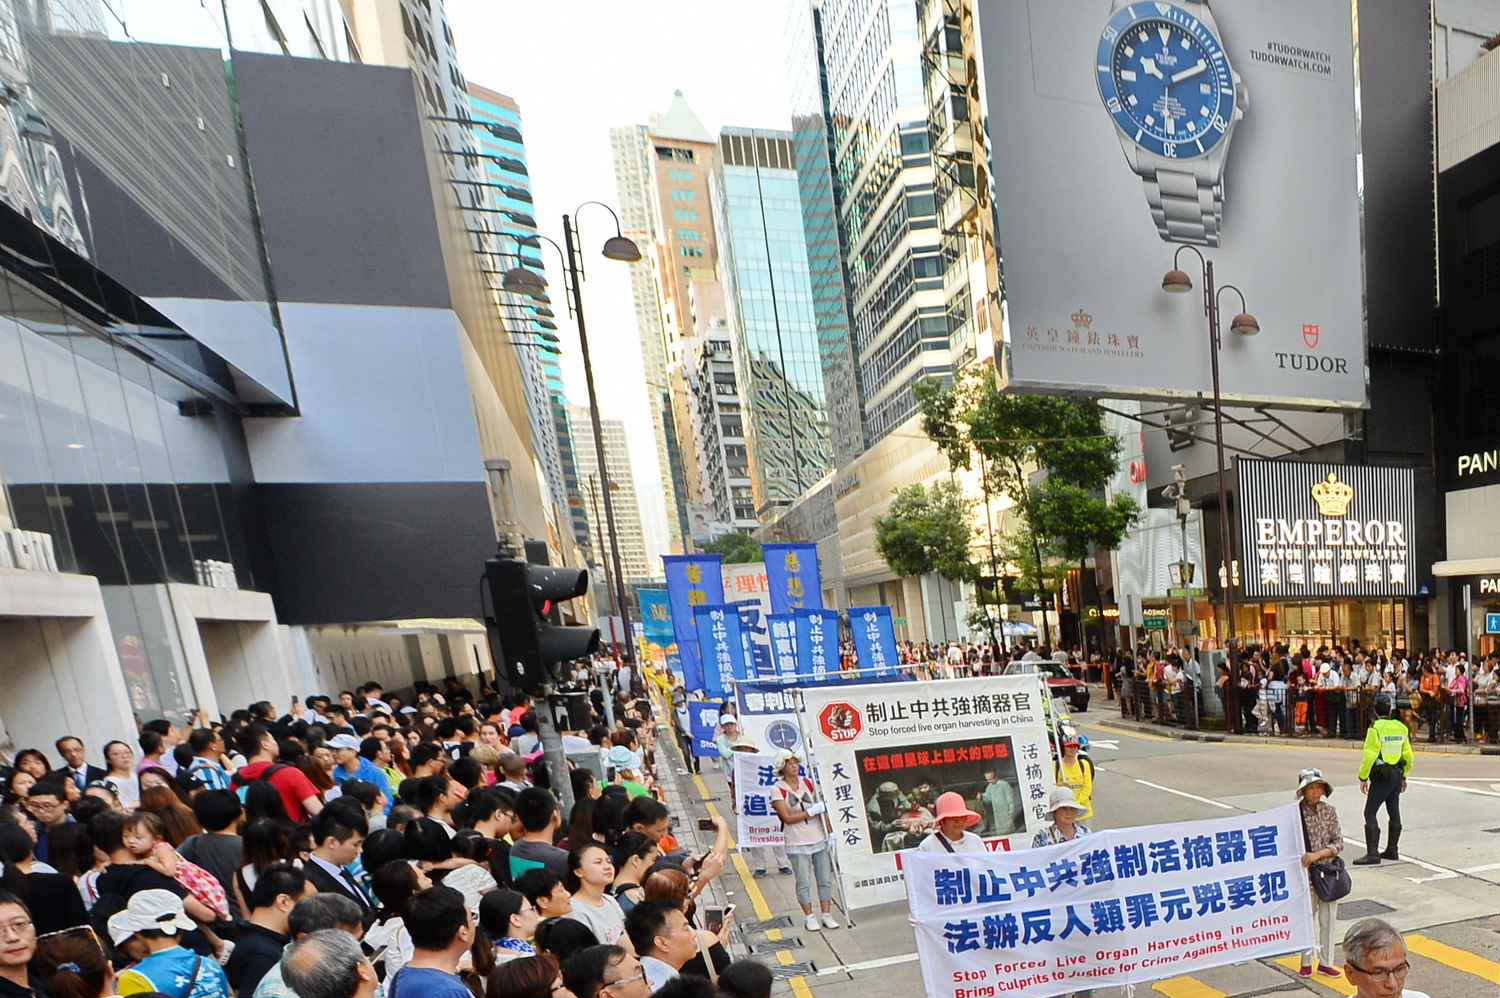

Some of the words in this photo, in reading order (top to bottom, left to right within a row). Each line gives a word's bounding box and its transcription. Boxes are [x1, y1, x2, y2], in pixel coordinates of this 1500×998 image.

[1250, 50, 1332, 75] TUDORWATCH.COM
[1267, 41, 1331, 63] #TUDORWATCH
[1164, 142, 1177, 158] 30
[1275, 352, 1348, 374] TUDOR
[1256, 518, 1406, 547] EMPEROR
[1258, 549, 1302, 560] WATCH
[1308, 549, 1334, 561] AND
[1340, 549, 1406, 561] JEWELLERY
[866, 692, 1032, 723] 制止中共強摘器官
[868, 727, 889, 737] Stop
[890, 724, 917, 734] forced
[918, 723, 932, 732] live
[934, 722, 957, 732] organ
[958, 717, 1000, 730] harvesting
[1001, 716, 1009, 725] in
[1010, 715, 1034, 724] China
[1021, 743, 1048, 821] 活摘器官
[831, 762, 862, 847] 天理不容
[748, 826, 770, 834] Bring
[750, 835, 785, 843] Investiga
[934, 824, 1279, 907] 制止中共強制活摘器官
[943, 869, 1290, 955] 法辦反人類罪元兇要犯
[952, 967, 987, 984] Stop
[995, 959, 1047, 977] Forced
[1056, 952, 1086, 968] Live
[1096, 946, 1139, 964] Organ
[1147, 929, 1222, 953] Harvesting
[1230, 923, 1244, 936] in
[1252, 913, 1289, 929] China
[997, 973, 1049, 994] Culprits
[1051, 970, 1065, 980] to
[1068, 963, 1116, 978] Justice
[1118, 959, 1138, 973] for
[1141, 953, 1180, 968] Crime
[1183, 941, 1229, 962] Against
[1231, 929, 1292, 950] Humanity
